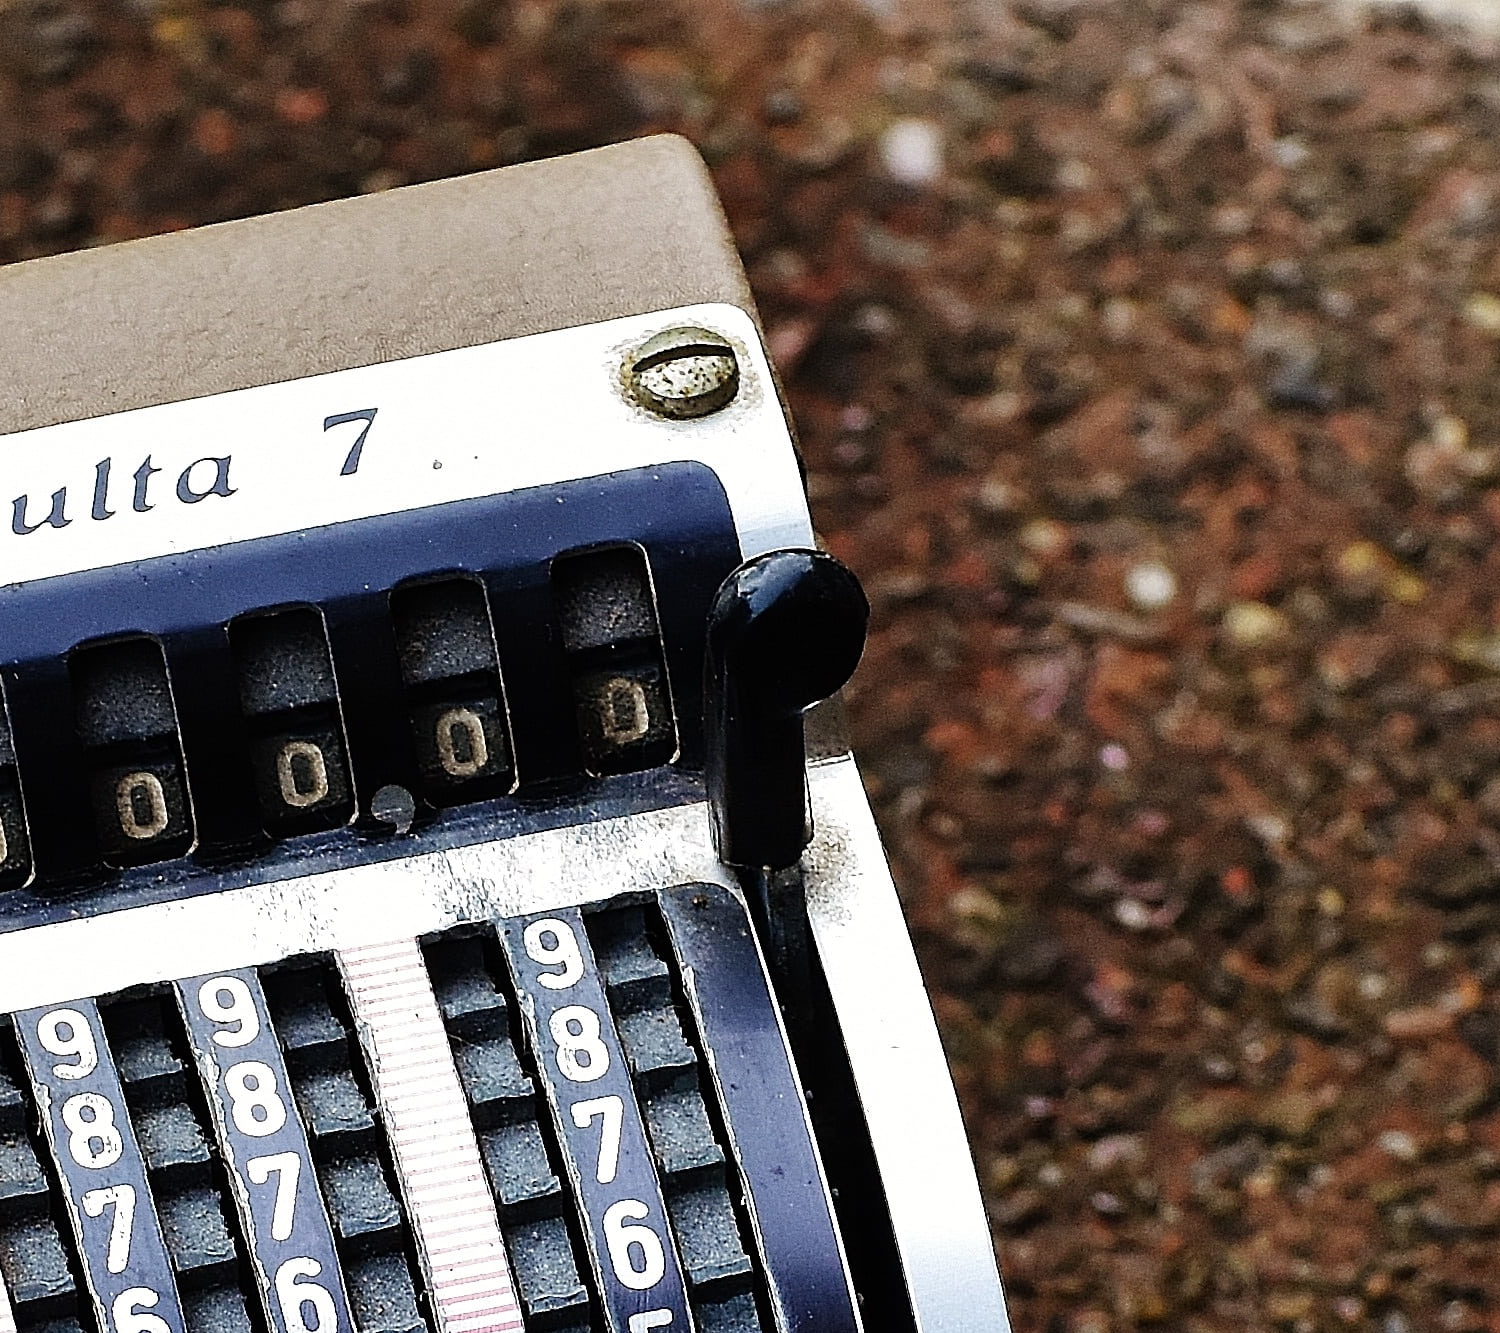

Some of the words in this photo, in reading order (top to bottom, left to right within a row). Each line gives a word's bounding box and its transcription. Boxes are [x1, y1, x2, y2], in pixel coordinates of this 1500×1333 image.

[323, 407, 379, 477] 7
[115, 771, 169, 839] 0
[276, 741, 328, 807] 0
[436, 708, 488, 776] 0
[600, 677, 650, 744] 0
[522, 917, 584, 991] 9
[35, 1008, 96, 1080] 9
[198, 976, 257, 1048] 9
[546, 1005, 611, 1082] 8
[60, 1092, 124, 1169] 8
[223, 1061, 287, 1138] 8
[571, 1094, 624, 1184] 7
[82, 1184, 137, 1275] 7
[246, 1150, 300, 1241] 7
[602, 1198, 666, 1291] 6
